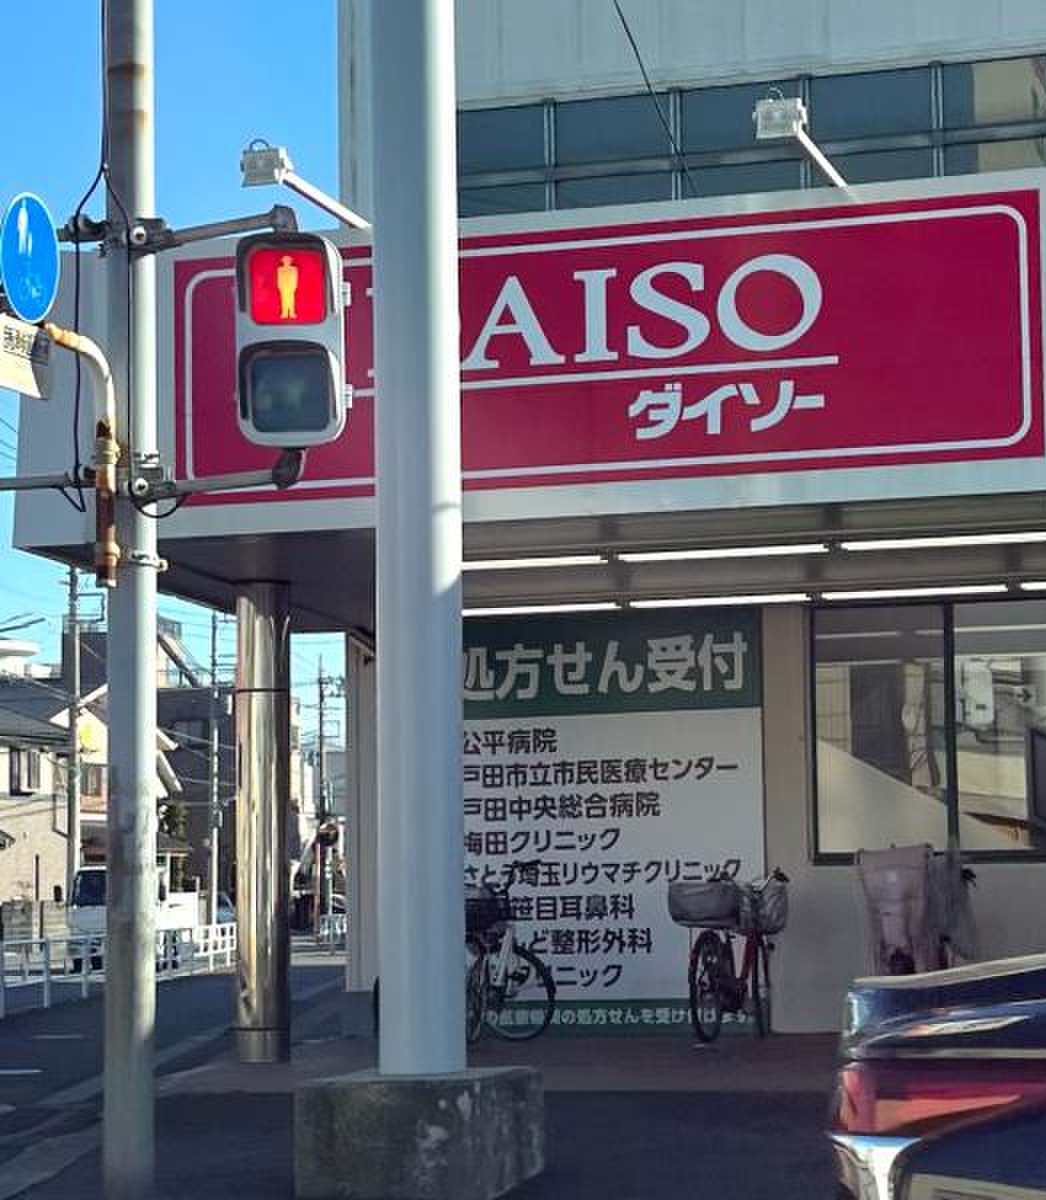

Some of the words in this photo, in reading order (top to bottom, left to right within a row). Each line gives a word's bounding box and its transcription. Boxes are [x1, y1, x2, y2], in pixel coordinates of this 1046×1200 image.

[366, 253, 823, 377] AISO
[628, 380, 825, 439] ダイソー
[463, 728, 557, 755] 公平病院
